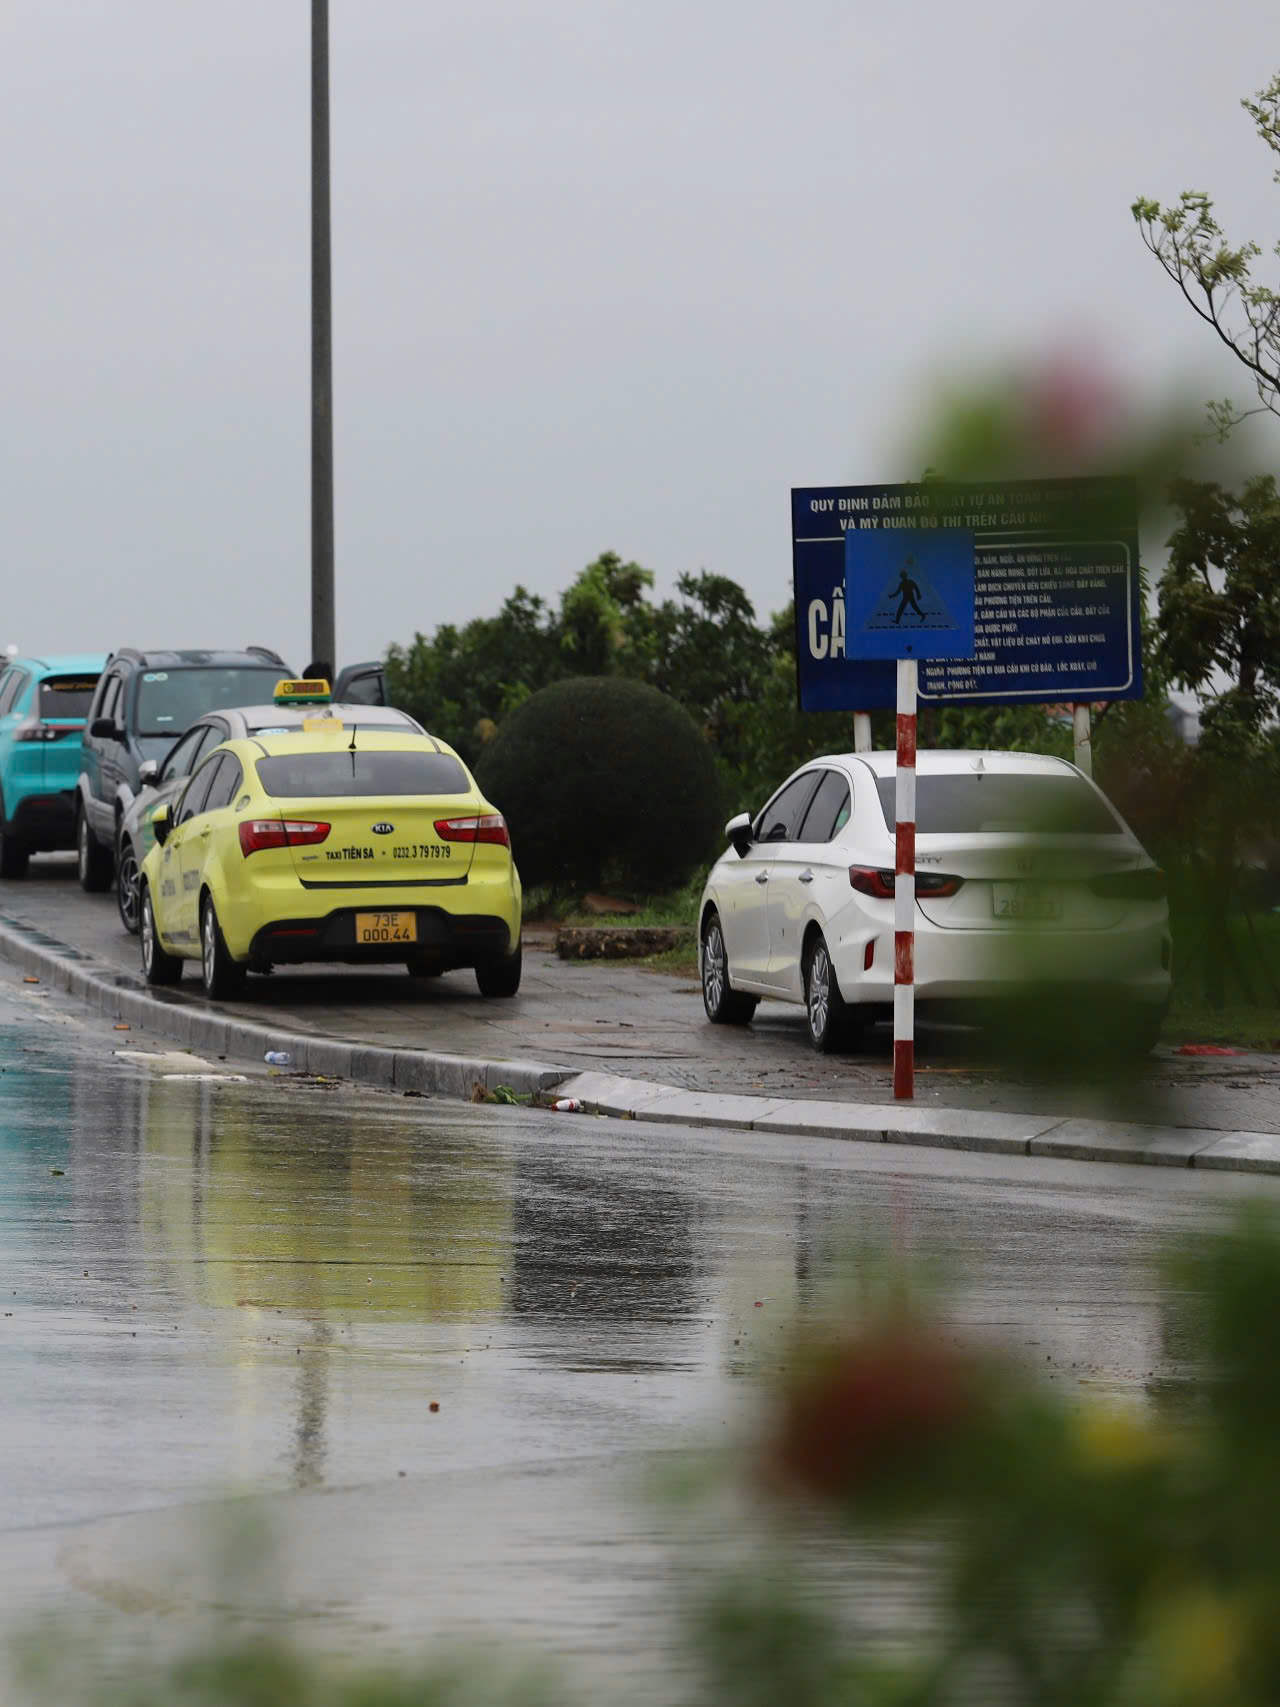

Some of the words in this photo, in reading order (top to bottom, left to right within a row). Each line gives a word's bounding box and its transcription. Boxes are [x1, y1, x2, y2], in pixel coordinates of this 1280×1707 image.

[810, 499, 834, 513] QUY
[838, 499, 868, 512] ĐỊNH
[872, 493, 901, 510] ĐẢM
[839, 517, 856, 531] VÀ
[882, 516, 916, 529] QUAN
[964, 512, 997, 528] TRÊN
[808, 578, 846, 660] CẦ
[374, 822, 393, 833] KIA
[326, 851, 341, 860] TAXI
[363, 848, 375, 859] SA
[374, 914, 399, 927] 73E
[363, 928, 410, 941] 000.44
